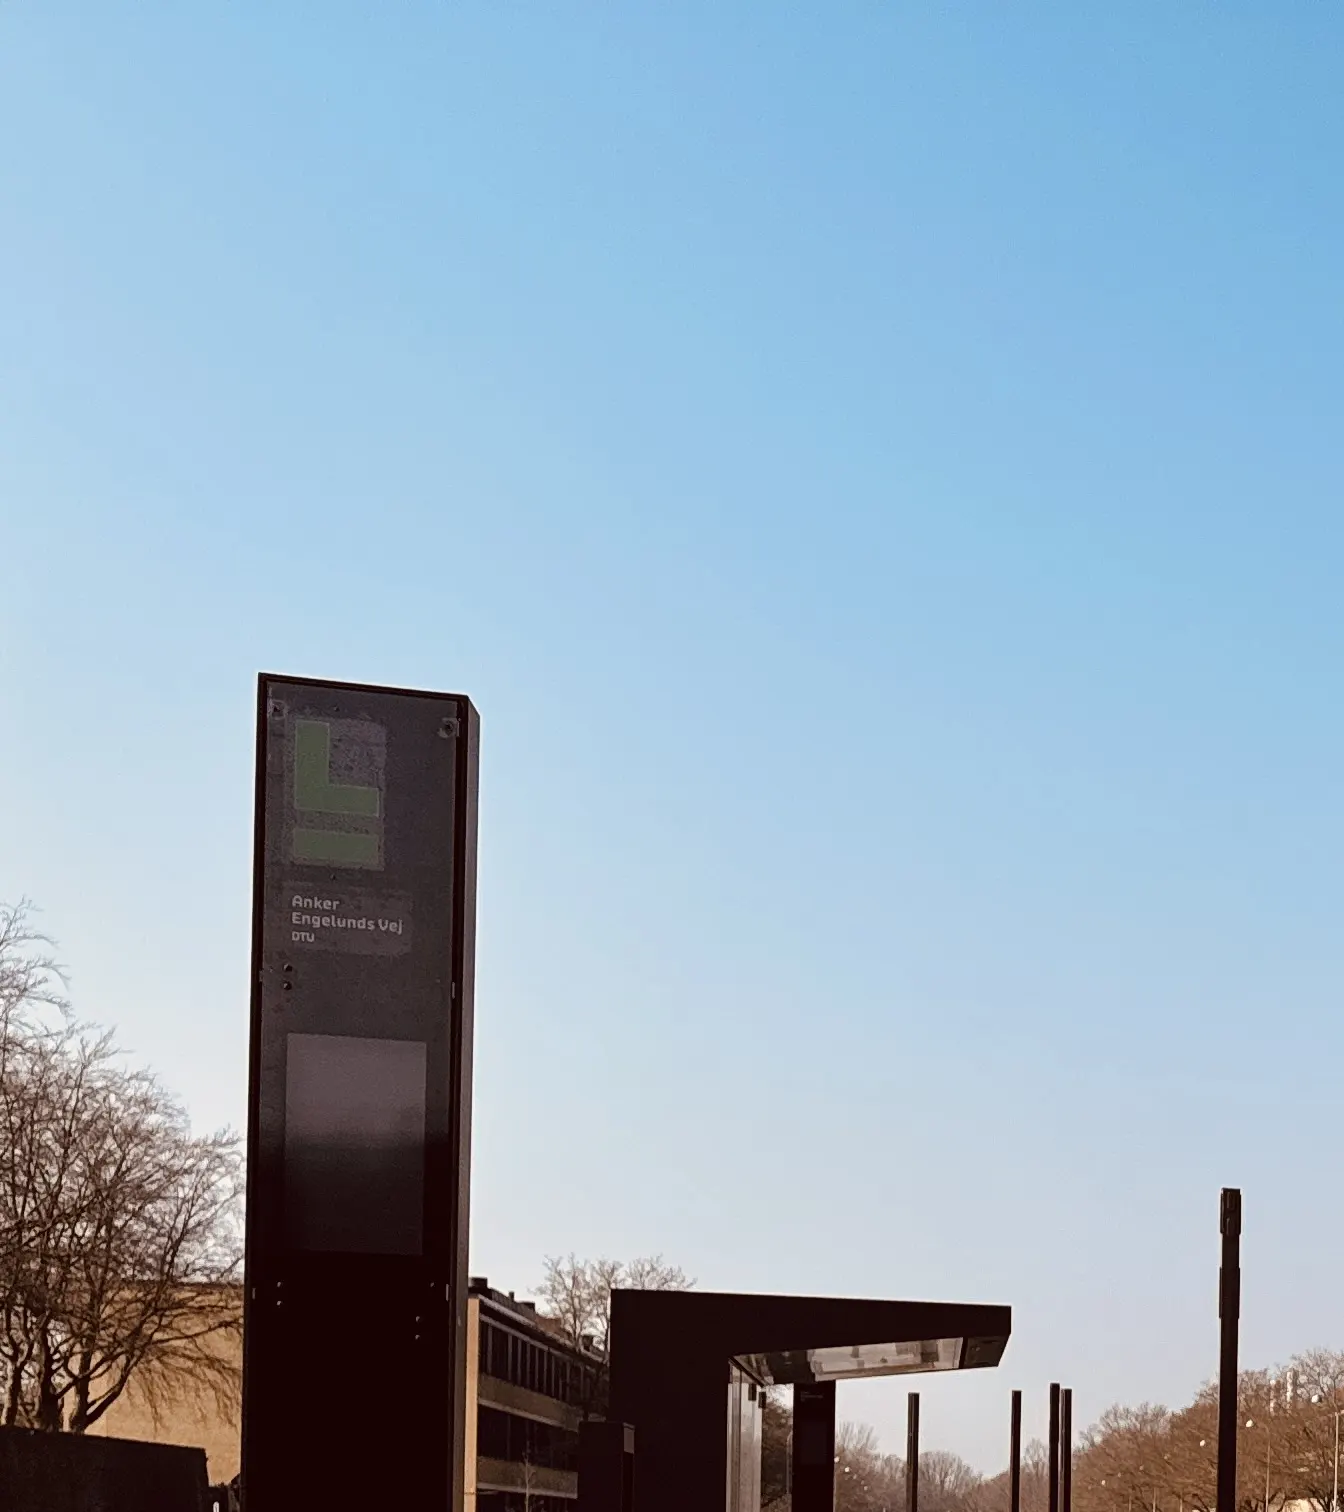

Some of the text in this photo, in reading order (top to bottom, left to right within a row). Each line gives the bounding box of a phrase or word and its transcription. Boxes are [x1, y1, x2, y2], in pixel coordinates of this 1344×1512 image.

[291, 894, 340, 911] Anker
[291, 911, 403, 936] Engelunds Vej
[291, 930, 316, 943] DTU
